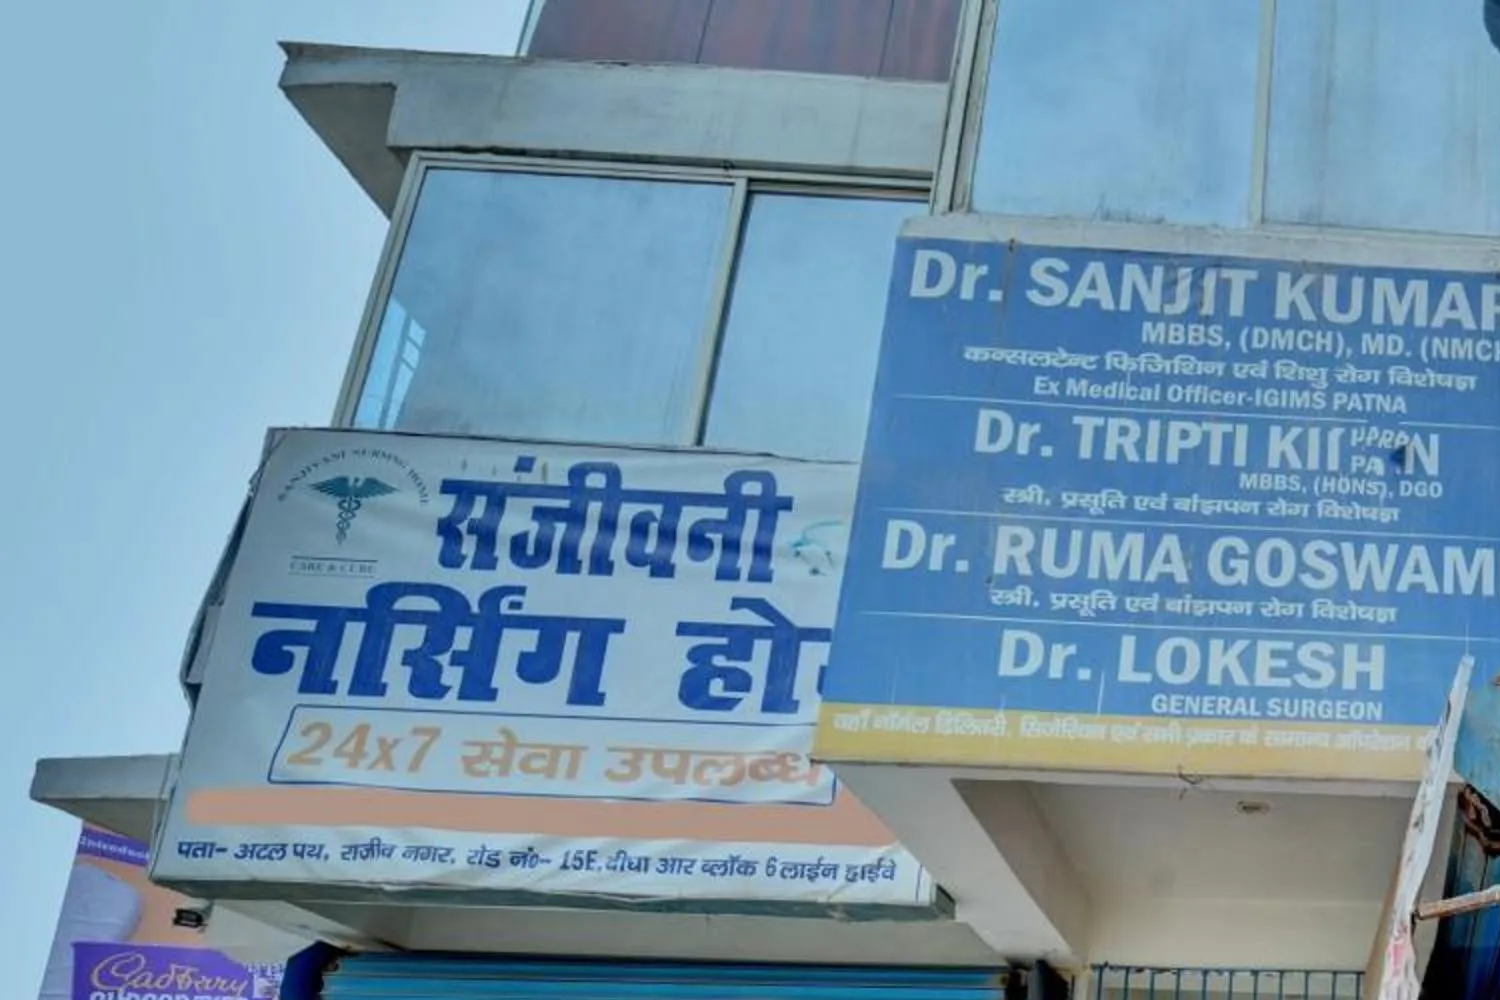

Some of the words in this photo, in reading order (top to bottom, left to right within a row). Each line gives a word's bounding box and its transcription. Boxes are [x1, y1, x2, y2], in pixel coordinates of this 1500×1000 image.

[909, 250, 1004, 300] Dr.
[1026, 257, 1259, 319] SANJIT
[1141, 320, 1231, 351] MBBS,
[1238, 326, 1354, 360] (DMCH),
[1361, 332, 1412, 357] MD.
[1232, 358, 1268, 381] एवं
[1333, 364, 1381, 386] रोग
[1033, 375, 1061, 397] Ex
[1066, 377, 1160, 401] Medical
[1331, 393, 1408, 414] PATNA
[974, 408, 1054, 457] Dr.
[1072, 415, 1249, 467] TRIPTI
[1238, 472, 1308, 494] MBBS,
[1399, 480, 1444, 499] DGO
[436, 455, 794, 584] संजीवनी
[1266, 498, 1310, 518] रोग
[882, 520, 970, 574] Dr.
[991, 527, 1190, 585] RUMA
[1125, 593, 1159, 613] एवं
[1260, 598, 1304, 619] रोग
[251, 581, 626, 706] नर्सिंग
[675, 596, 833, 716] हो
[998, 628, 1092, 681] Dr.
[1116, 633, 1386, 692] LOKESH
[1151, 694, 1261, 718] GENERAL
[1266, 699, 1384, 722] SURGEON
[286, 719, 442, 771] 24x7
[461, 727, 588, 784] सेवा
[233, 841, 288, 861] अटल
[340, 836, 393, 862] राजीव
[765, 855, 777, 878] 6
